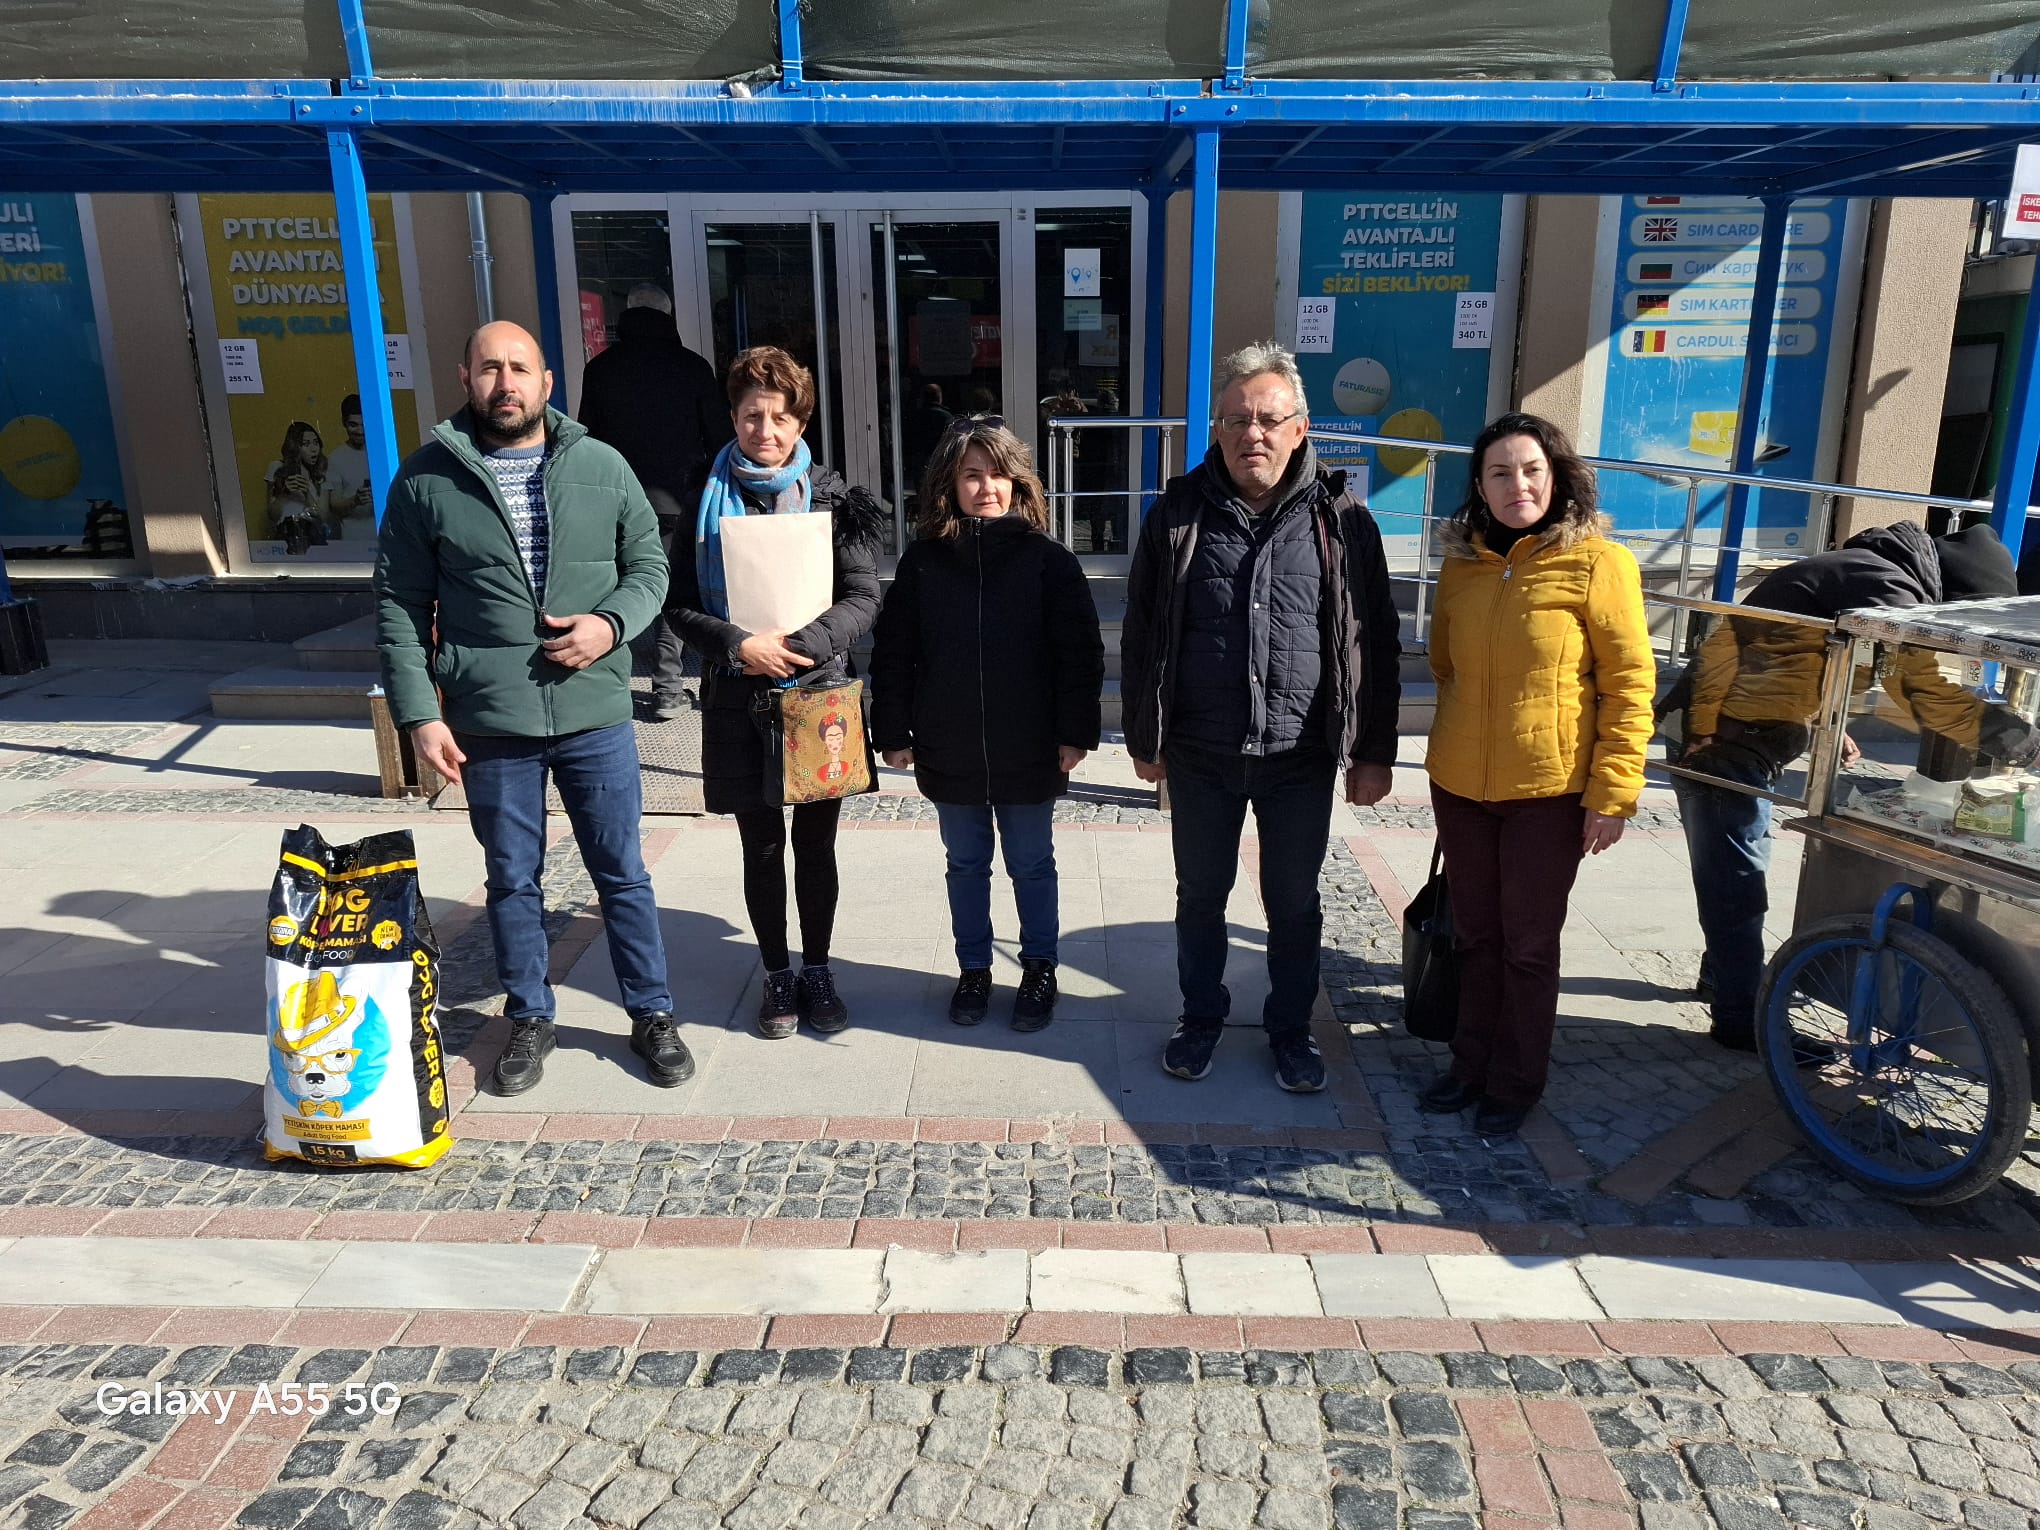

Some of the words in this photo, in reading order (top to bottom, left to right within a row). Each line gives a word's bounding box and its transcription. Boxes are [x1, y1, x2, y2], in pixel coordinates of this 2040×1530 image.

[2022, 195, 2040, 206] İSKE
[1343, 197, 1458, 221] PTTCELL'İN
[1342, 226, 1455, 245] AVANTAJLI
[1687, 224, 1715, 237] SIM
[1717, 224, 1760, 237] CARD
[0, 226, 41, 252] ERİ
[1340, 246, 1455, 269] TEKLİFLERİ
[1322, 273, 1361, 294] SİZİ
[1363, 272, 1471, 293] BEKLİYOR!
[1302, 304, 1313, 314] 12
[1315, 304, 1329, 314] GB
[1460, 300, 1472, 309] 25
[1474, 300, 1488, 309] GB
[1680, 299, 1706, 312] SIM
[1300, 335, 1317, 344] 255
[1318, 335, 1329, 344] TL
[1458, 330, 1475, 339] 340
[1477, 330, 1488, 339] TL
[1676, 335, 1735, 348] CARDUL
[335, 1121, 365, 1131] MAMASI
[311, 1145, 325, 1155] 15
[326, 1146, 346, 1159] kg
